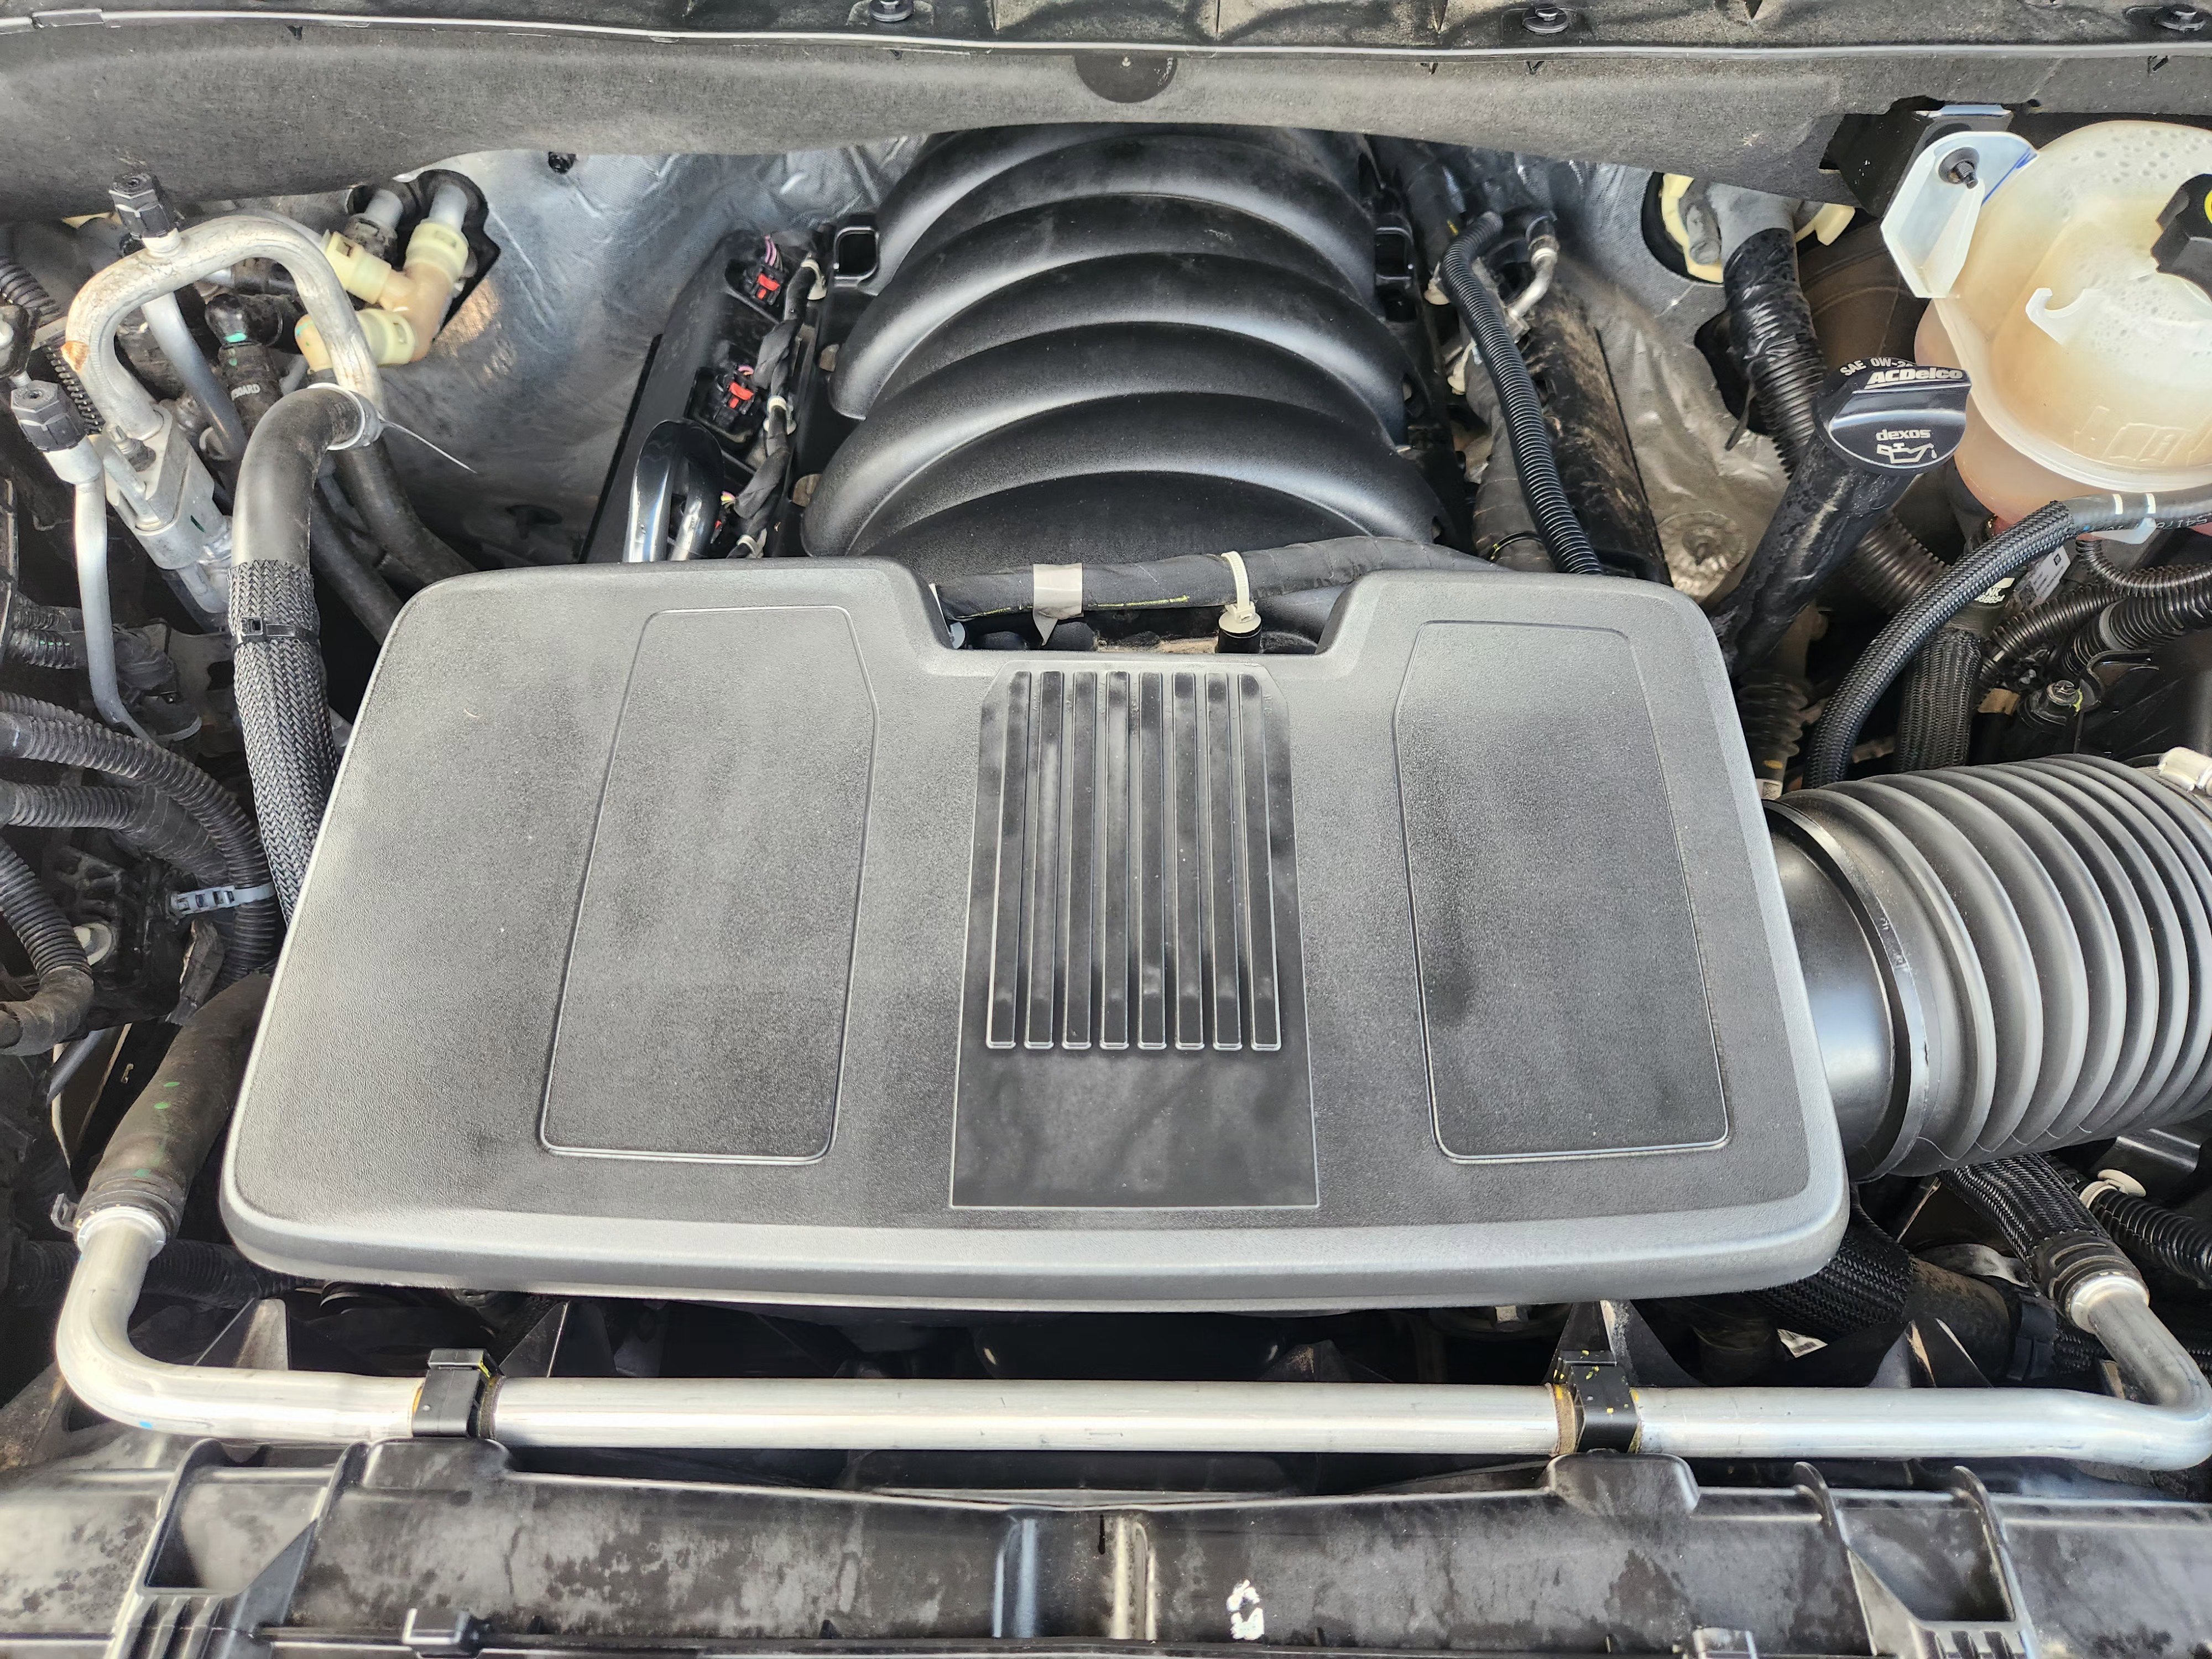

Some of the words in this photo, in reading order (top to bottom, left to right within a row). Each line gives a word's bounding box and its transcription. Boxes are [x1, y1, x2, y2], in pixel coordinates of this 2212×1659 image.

[1839, 360, 1867, 376] SAE
[1866, 367, 1963, 385] ACDelco
[1875, 429, 1932, 441] dexos
